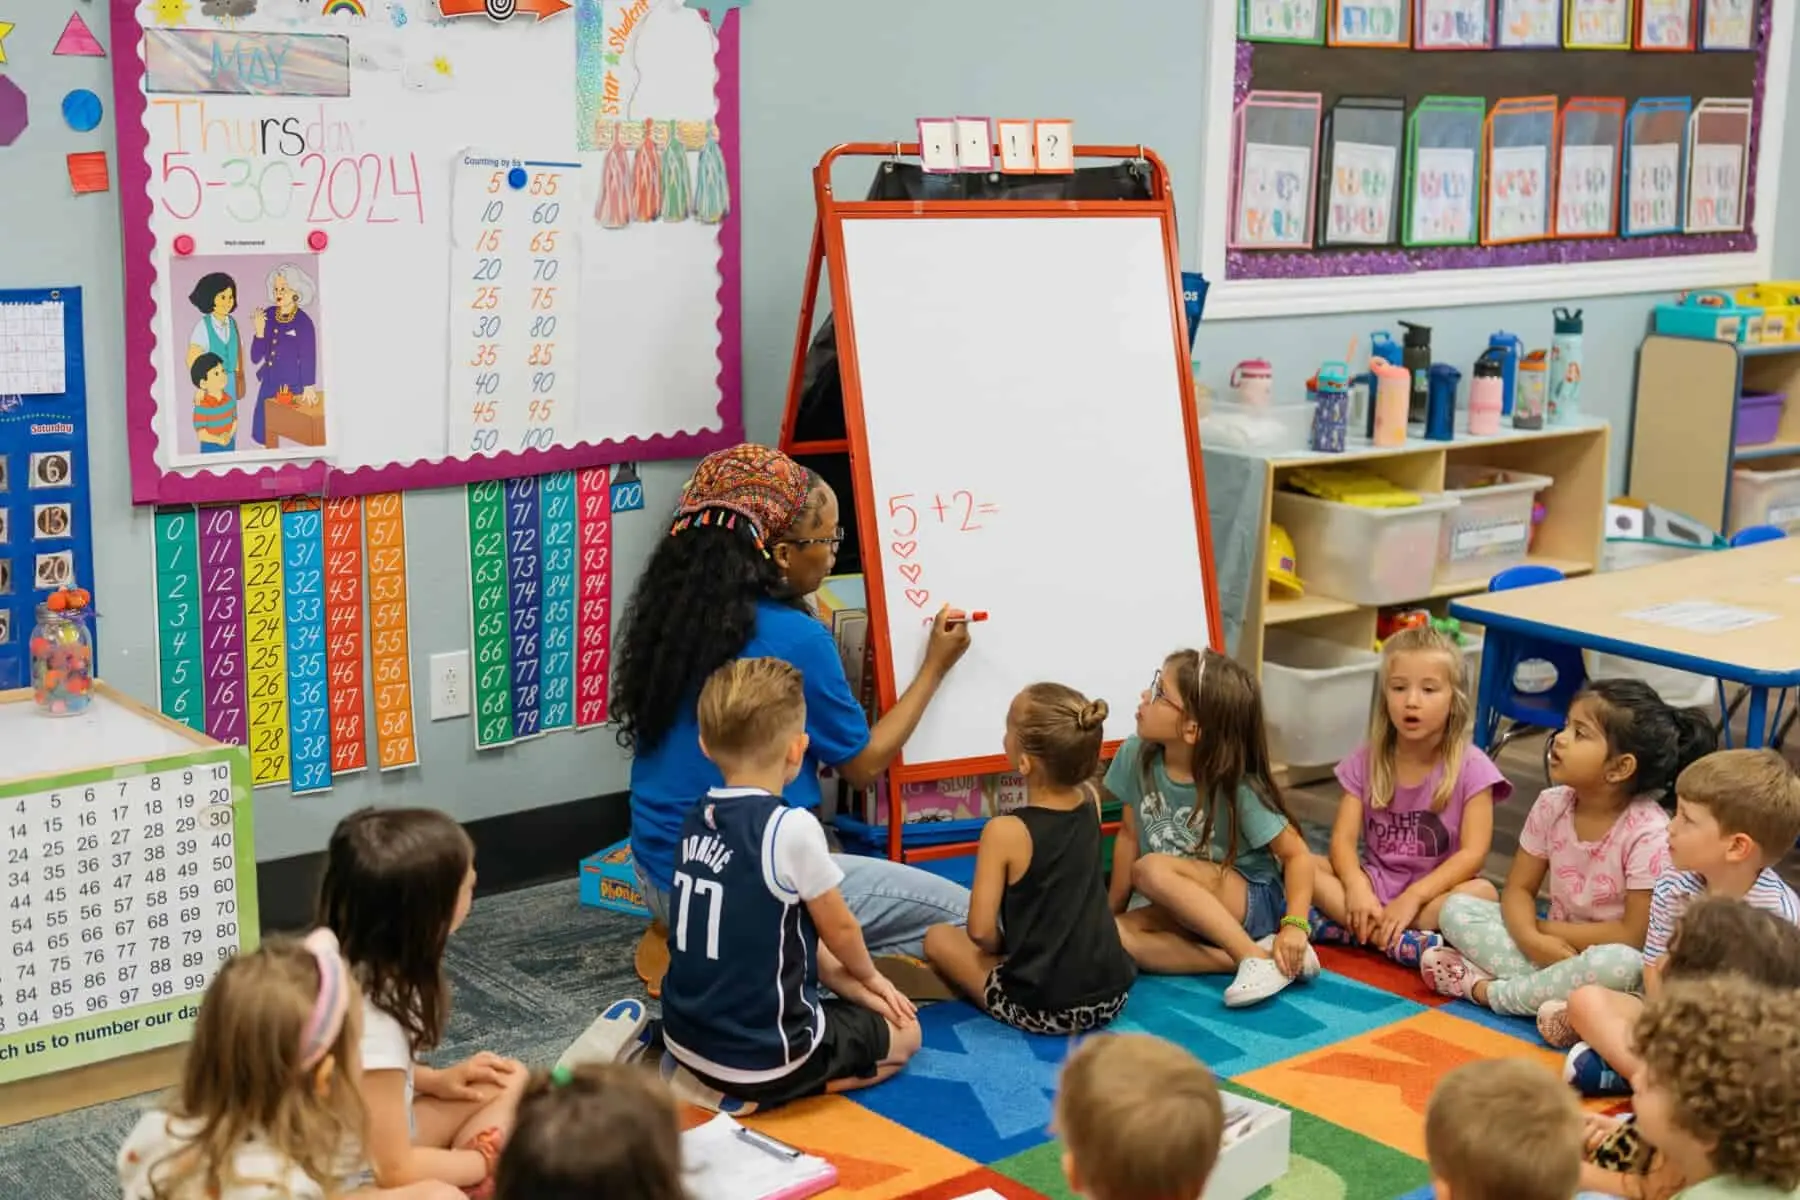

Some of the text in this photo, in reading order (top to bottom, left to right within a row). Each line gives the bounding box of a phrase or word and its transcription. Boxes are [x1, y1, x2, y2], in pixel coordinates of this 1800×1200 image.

[209, 38, 290, 86] MAY
[602, 70, 620, 115] Star
[464, 156, 499, 169] Counting
[161, 151, 424, 224] 5-30-2024
[487, 171, 504, 193] 5
[530, 173, 562, 195] 55
[481, 200, 503, 223] 10
[533, 203, 559, 224] 60
[476, 229, 503, 252] 15
[530, 231, 559, 252] 65
[472, 258, 502, 281] 20
[534, 260, 559, 280] 70
[471, 287, 502, 309] 25
[531, 287, 558, 309] 75
[472, 316, 501, 338] 30
[530, 316, 556, 337] 80
[471, 344, 500, 367] 35
[528, 343, 555, 365] 85
[475, 373, 499, 395] 40
[533, 372, 555, 393] 90
[473, 400, 502, 424] 45
[529, 400, 552, 421] 95
[31, 423, 73, 434] Saturday
[471, 429, 499, 451] 50
[520, 427, 554, 449] 100
[46, 454, 61, 482] 6
[612, 485, 641, 510] 100
[43, 506, 65, 532] 13
[206, 510, 232, 535] 10
[245, 504, 277, 529] 20
[286, 514, 318, 538] 30
[512, 503, 532, 525] 71
[889, 494, 917, 537] 5
[167, 516, 184, 540] 0
[208, 539, 232, 563] 11
[248, 534, 276, 557] 21
[512, 529, 535, 552] 72
[170, 545, 182, 569] 1
[289, 542, 315, 566] 31
[41, 554, 70, 584] 20
[248, 561, 280, 586] 22
[512, 555, 537, 578] 73
[168, 574, 187, 598] 2
[208, 568, 235, 592] 12
[288, 570, 320, 594] 32
[248, 589, 280, 615] 23
[515, 582, 536, 606] 74
[169, 603, 188, 626] 3
[208, 596, 236, 621] 13
[288, 598, 320, 622] 33
[514, 608, 538, 631] 75
[210, 623, 236, 649] 14
[250, 618, 279, 642] 24
[291, 625, 321, 650] 34
[173, 632, 187, 655] 4
[515, 632, 538, 657] 76
[211, 652, 239, 677] 15
[251, 645, 281, 670] 25
[291, 653, 324, 678] 35
[172, 660, 190, 684] 5
[516, 659, 538, 682] 77
[212, 680, 238, 704] 16
[252, 673, 282, 697] 26
[293, 681, 323, 705] 36
[517, 684, 538, 708] 78
[174, 689, 190, 712] 6
[213, 709, 240, 734] 17
[253, 700, 283, 726] 27
[294, 708, 325, 732] 37
[517, 709, 538, 735] 79
[254, 728, 283, 753] 28
[296, 736, 325, 759] 38
[256, 756, 284, 780] 29
[297, 762, 326, 786] 39
[16, 765, 228, 813] 4 5 6 7 8 9 10
[11, 788, 229, 839] 14 15 16 17 18 19 20
[9, 810, 230, 864] 24 25 26 27 28 29 30
[1377, 839, 1418, 857] FACE
[11, 856, 232, 909] 44 45 46 47 48 49 50
[600, 877, 645, 905] Phonic
[674, 870, 724, 961] 77
[13, 900, 235, 956] 64 65 66 67 68 69 70
[16, 987, 36, 1003] 84
[51, 979, 72, 995] 85
[85, 972, 105, 988] 86
[119, 965, 137, 981] 87
[151, 958, 171, 974] 88
[183, 952, 203, 967] 89
[18, 974, 204, 1026] 94 95 96 97 98 99
[25, 1040, 46, 1055] us
[51, 1034, 69, 1049] to
[75, 1016, 141, 1044] number
[145, 1010, 174, 1027] our
[178, 1005, 202, 1020] da
